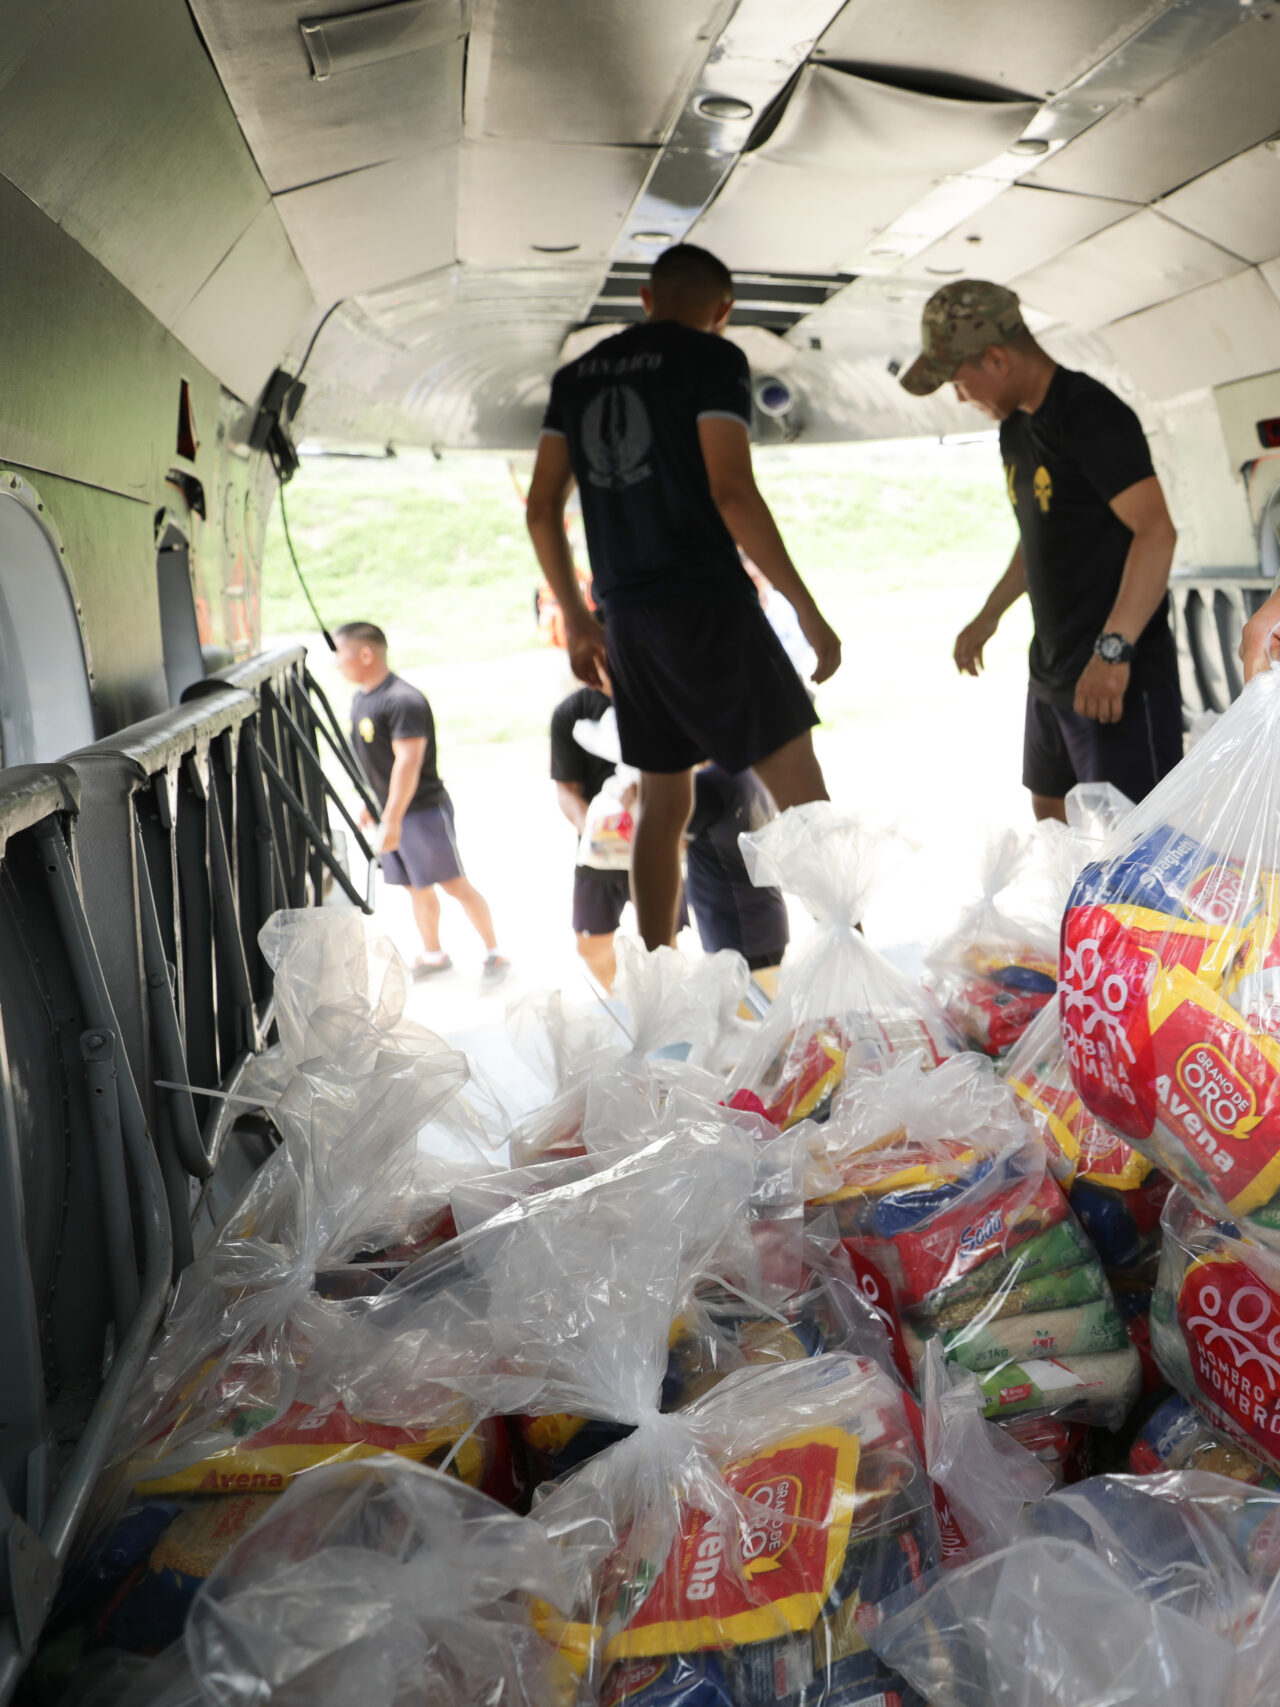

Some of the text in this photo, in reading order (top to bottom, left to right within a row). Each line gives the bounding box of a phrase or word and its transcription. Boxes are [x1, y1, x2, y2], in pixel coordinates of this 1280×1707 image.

[1139, 837, 1201, 890] Spaghetti
[1184, 1063, 1237, 1131] ORO
[1196, 1051, 1250, 1113] GRANO DE
[1155, 1074, 1235, 1173] Avena
[960, 1210, 1003, 1252] Soda
[1196, 1340, 1265, 1402] HOMBRO
[198, 1468, 284, 1489] Avena
[686, 1513, 726, 1601] vena
